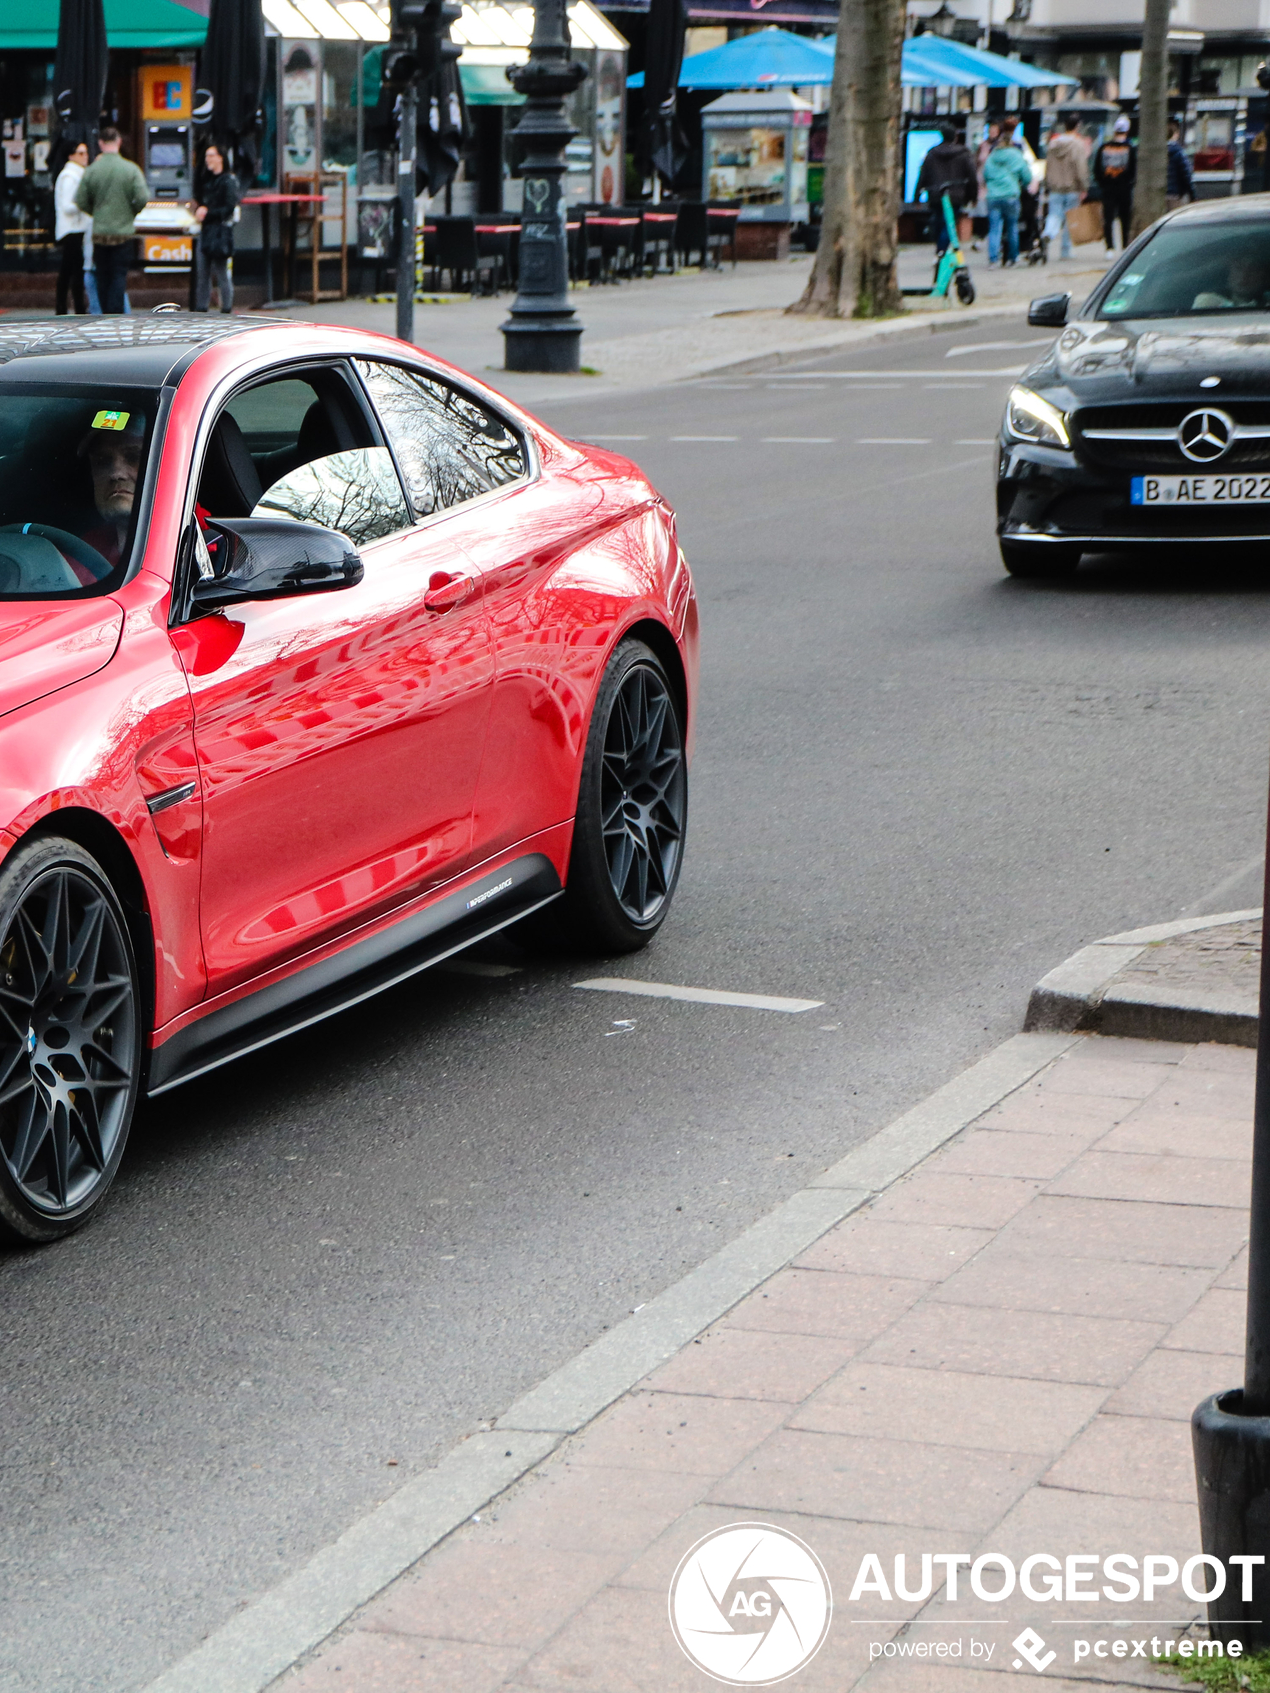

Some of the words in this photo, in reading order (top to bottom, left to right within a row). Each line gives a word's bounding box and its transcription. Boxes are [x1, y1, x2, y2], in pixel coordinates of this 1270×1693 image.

[153, 81, 181, 109] EC
[148, 244, 192, 261] Cash
[101, 418, 118, 427] 21
[1146, 479, 1160, 501] B
[1176, 479, 1208, 501] AE
[1213, 477, 1270, 500] 2022
